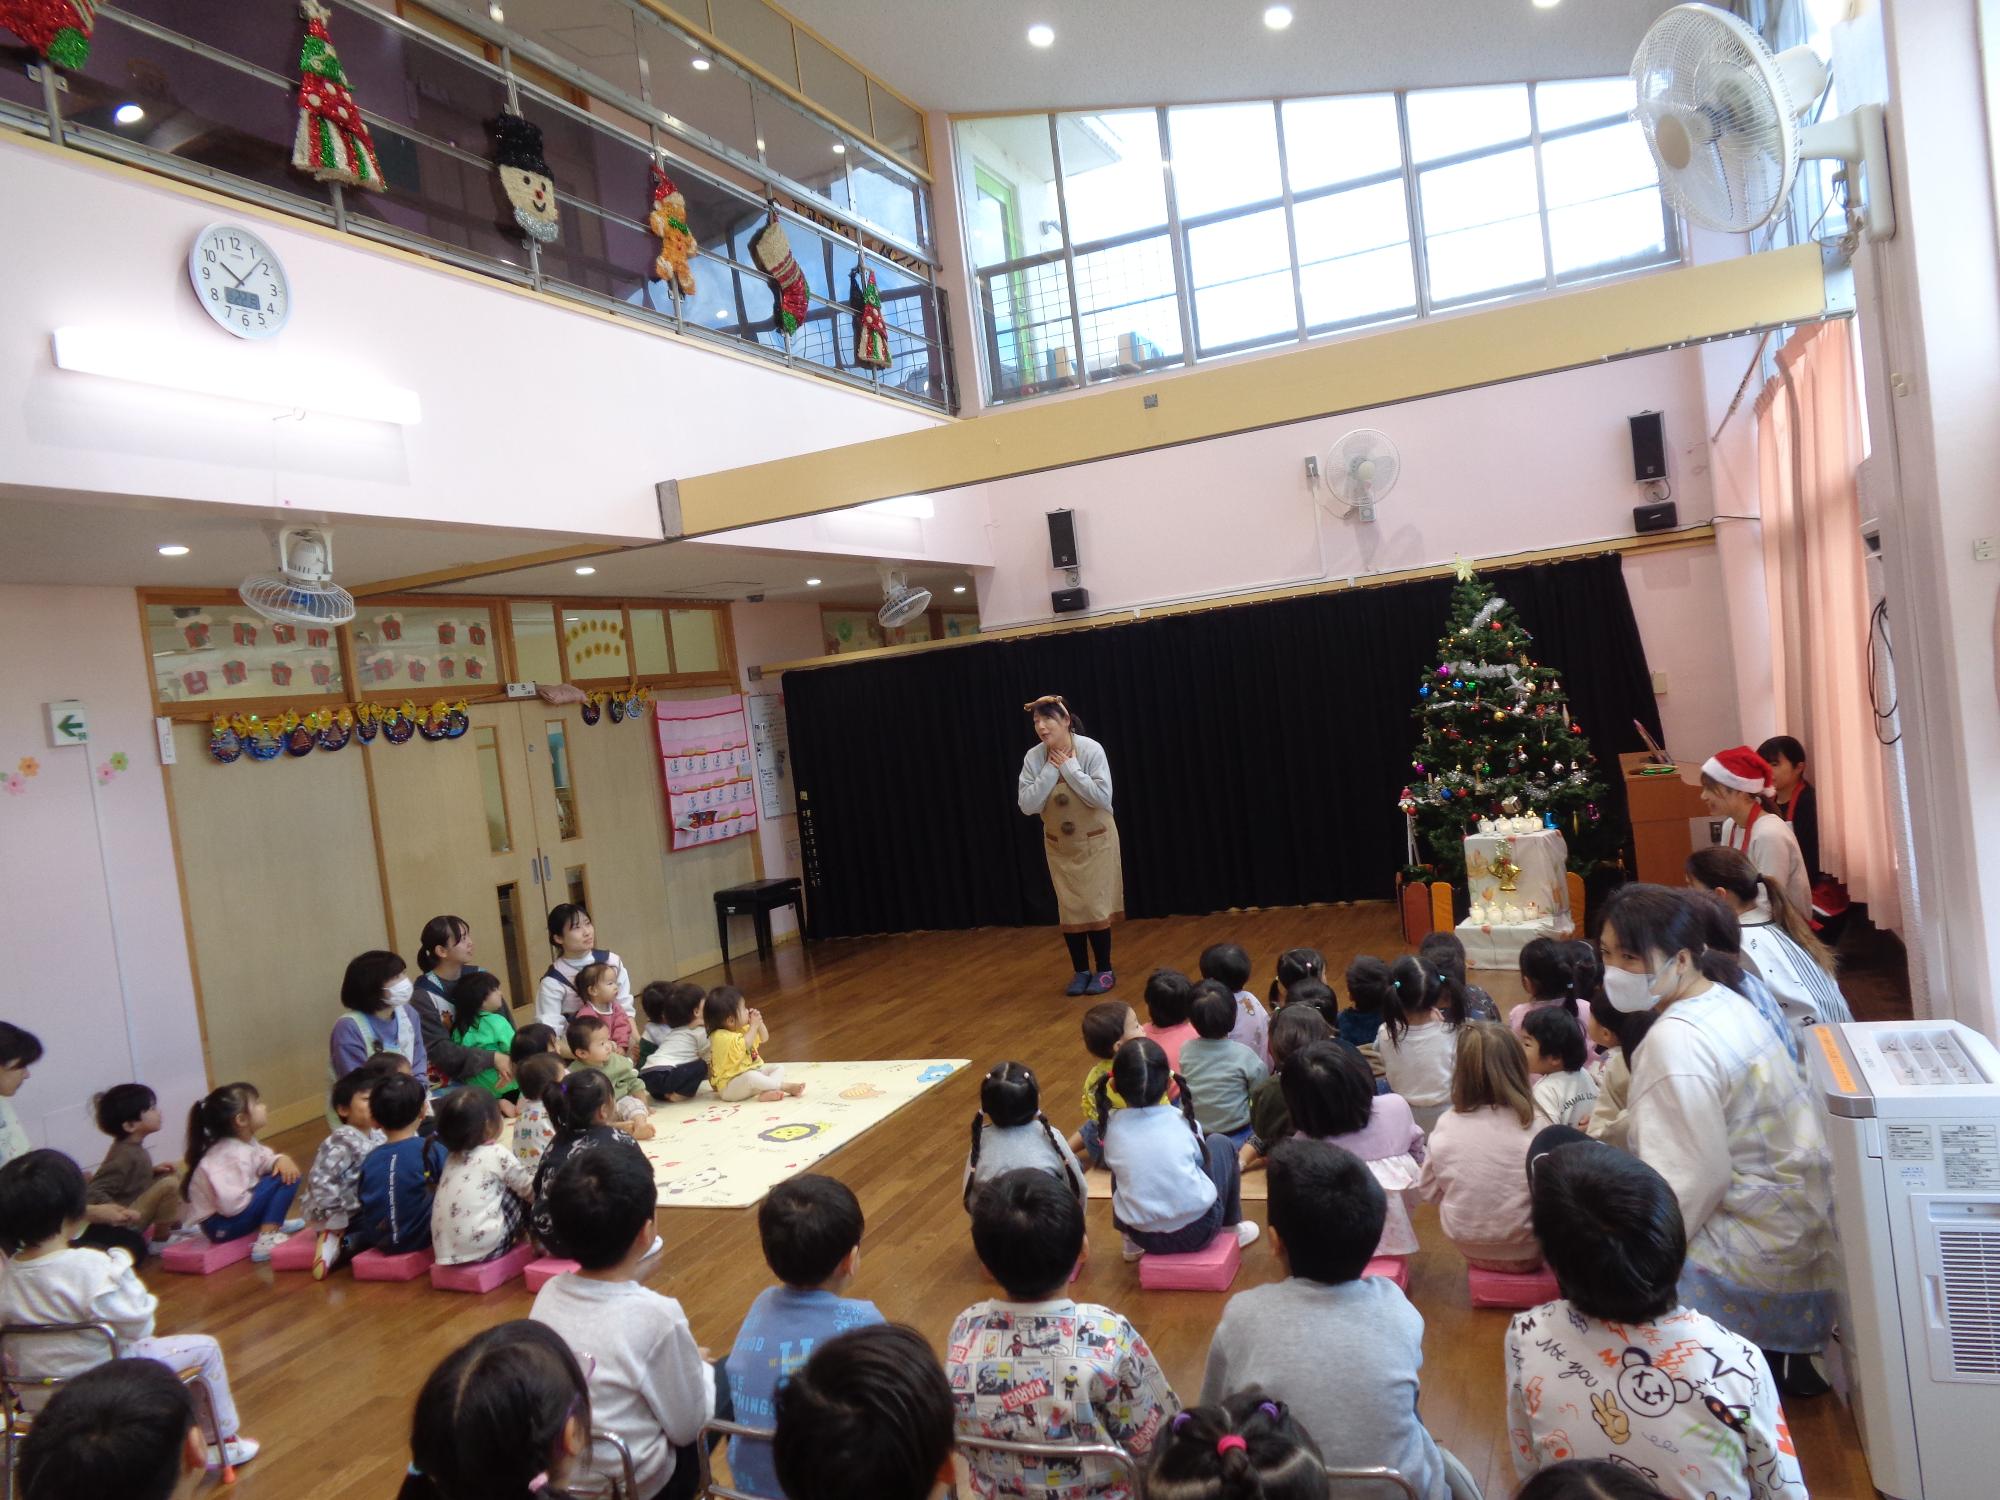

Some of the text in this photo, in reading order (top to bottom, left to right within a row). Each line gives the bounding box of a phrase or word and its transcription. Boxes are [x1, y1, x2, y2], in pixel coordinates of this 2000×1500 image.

[214, 238, 224, 251] 11
[230, 237, 242, 251] 12
[204, 249, 216, 263] 10
[250, 247, 255, 260] 1
[202, 267, 209, 279] 9
[262, 263, 269, 276] 2
[210, 288, 218, 301] 8
[270, 284, 277, 296] 3
[225, 306, 231, 318] 7
[267, 303, 274, 314] 4
[242, 314, 249, 326] 6
[258, 313, 265, 325] 5
[1536, 1338, 1567, 1361] Not
[1558, 1361, 1599, 1388] you
[1001, 1378, 1047, 1410] MARVEL
